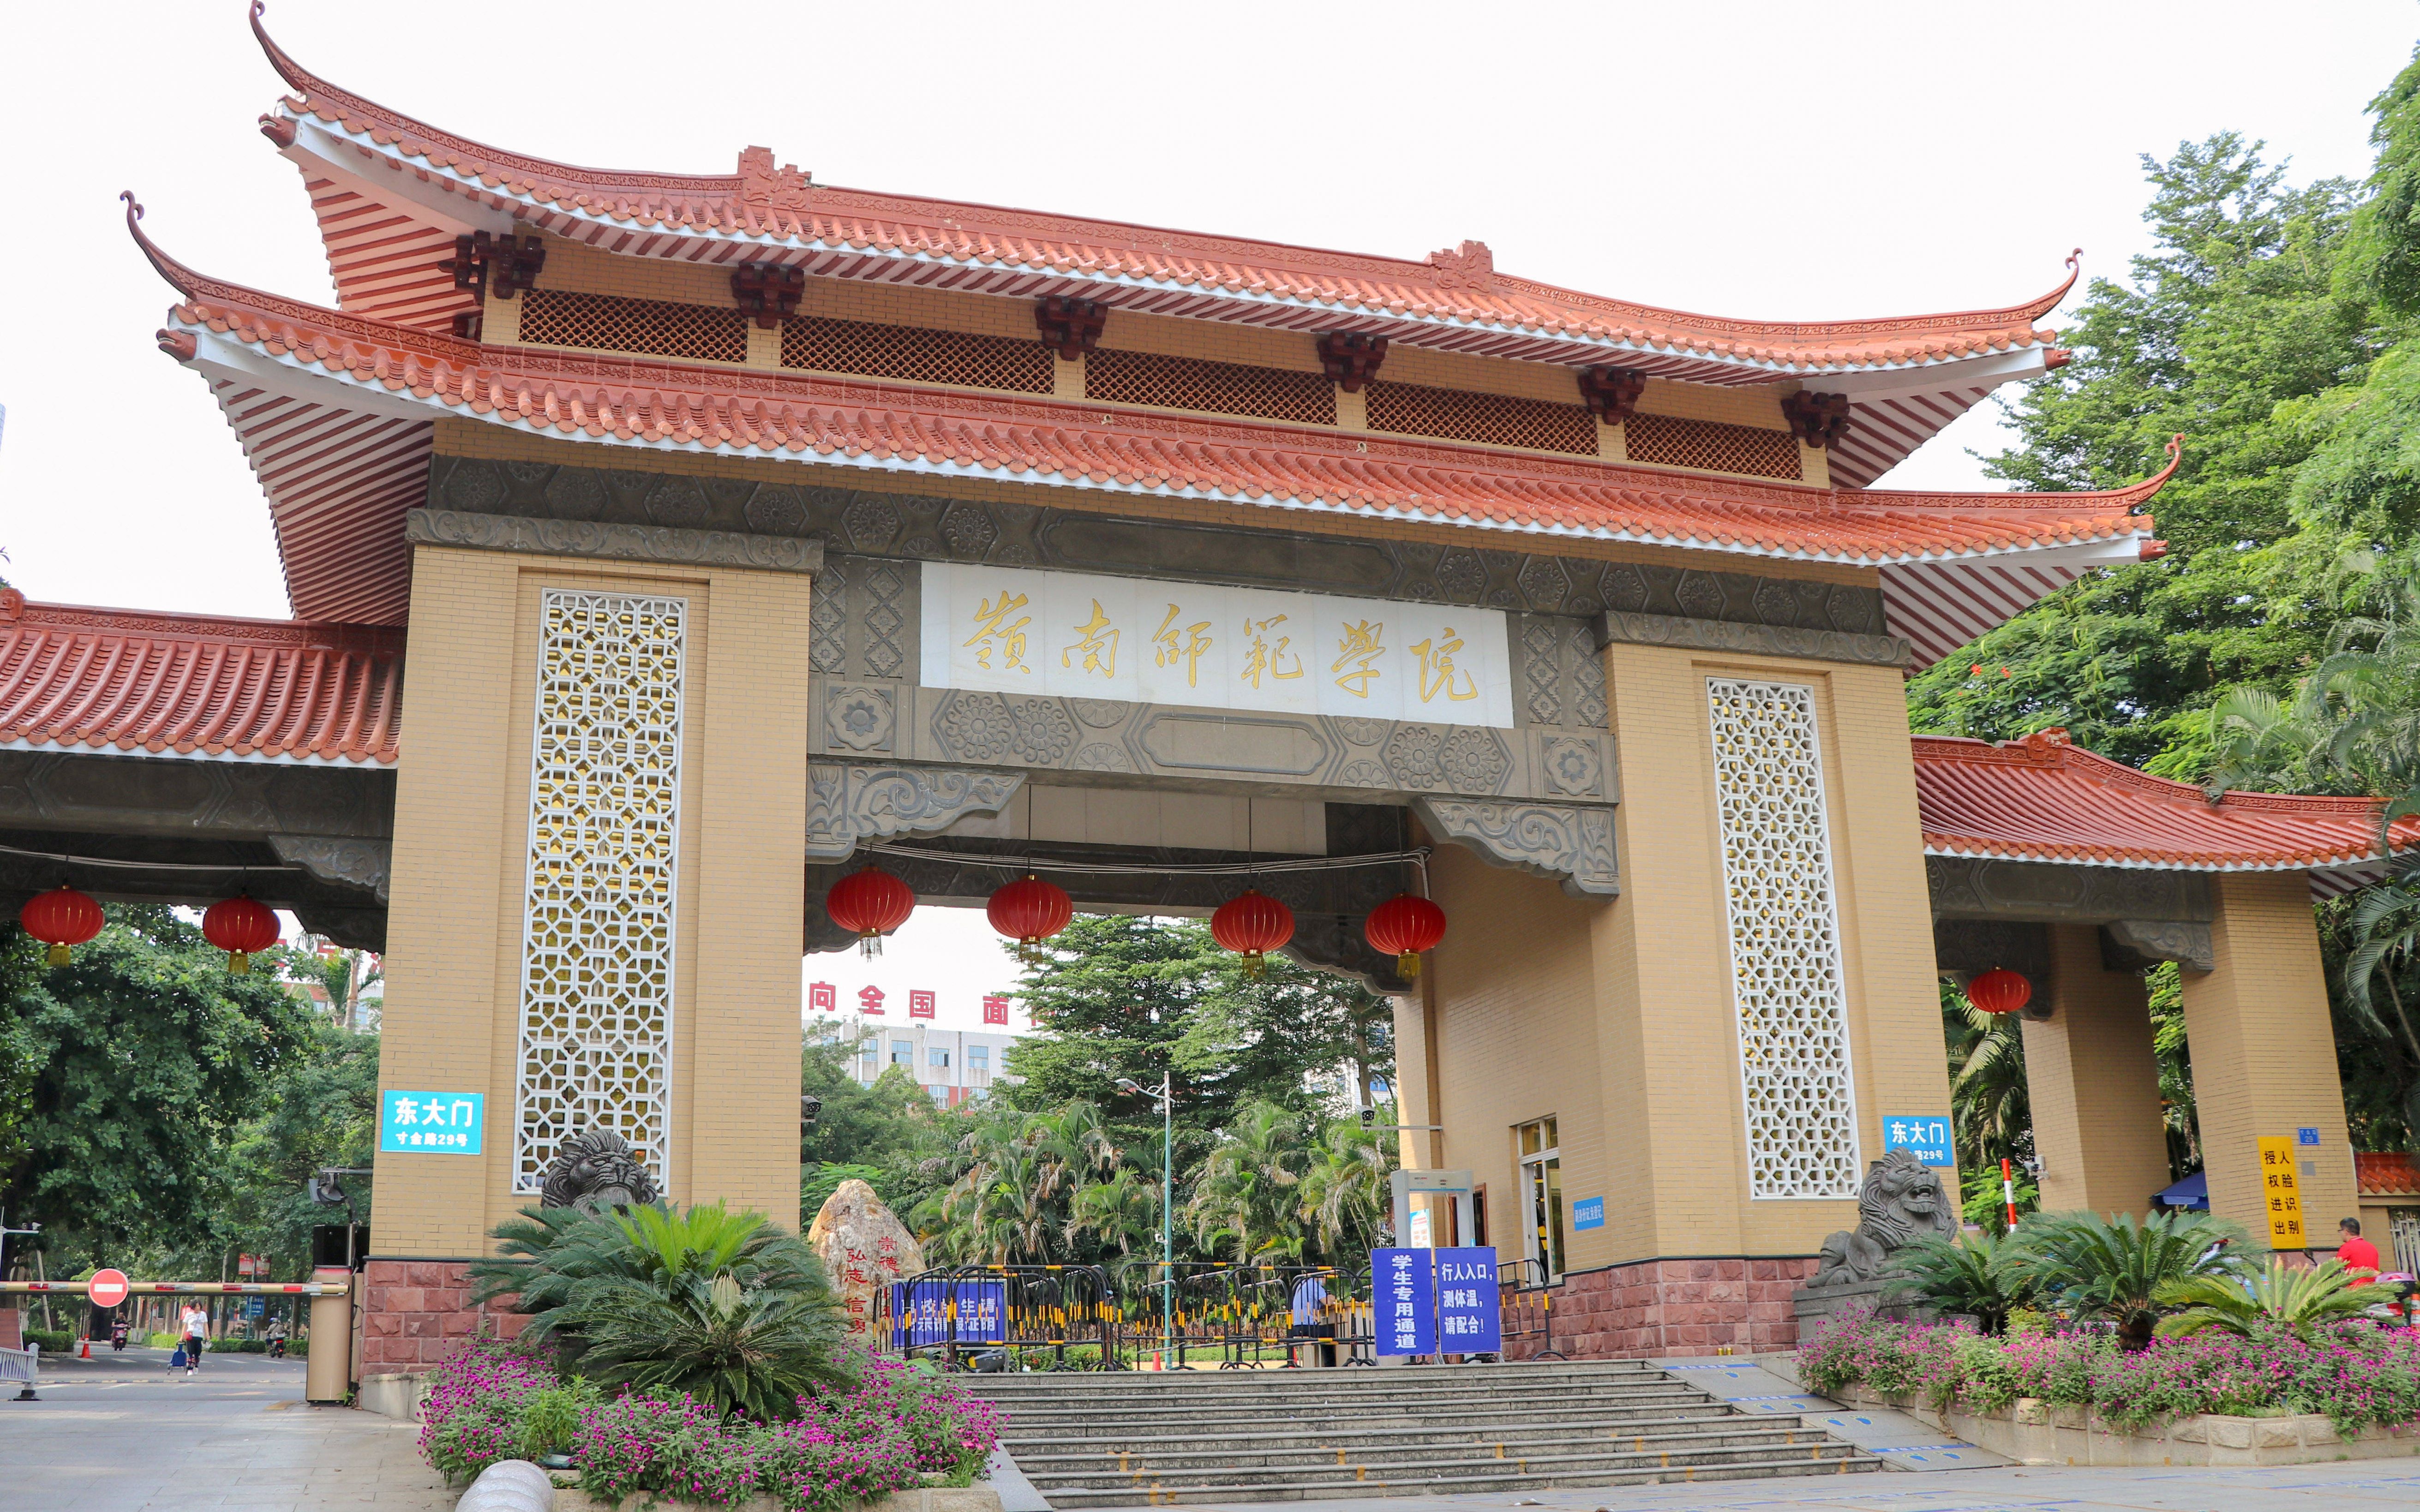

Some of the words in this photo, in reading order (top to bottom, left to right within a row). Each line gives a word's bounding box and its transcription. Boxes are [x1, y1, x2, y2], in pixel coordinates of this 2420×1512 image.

[809, 981, 935, 1019] 向全国
[394, 1097, 473, 1127] 东大门
[395, 1131, 468, 1147] 寸金路29号
[1891, 1121, 1945, 1144] 东大门
[1909, 1149, 1944, 1160] 路29号
[2265, 1150, 2286, 1235] 授权进出
[2279, 1150, 2300, 1234] 人脸识别
[1442, 1263, 1493, 1282] 行人入口，
[1391, 1255, 1417, 1349] 学生专用通道
[1443, 1289, 1483, 1309] 测体温，
[1445, 1316, 1485, 1335] 请配合！
